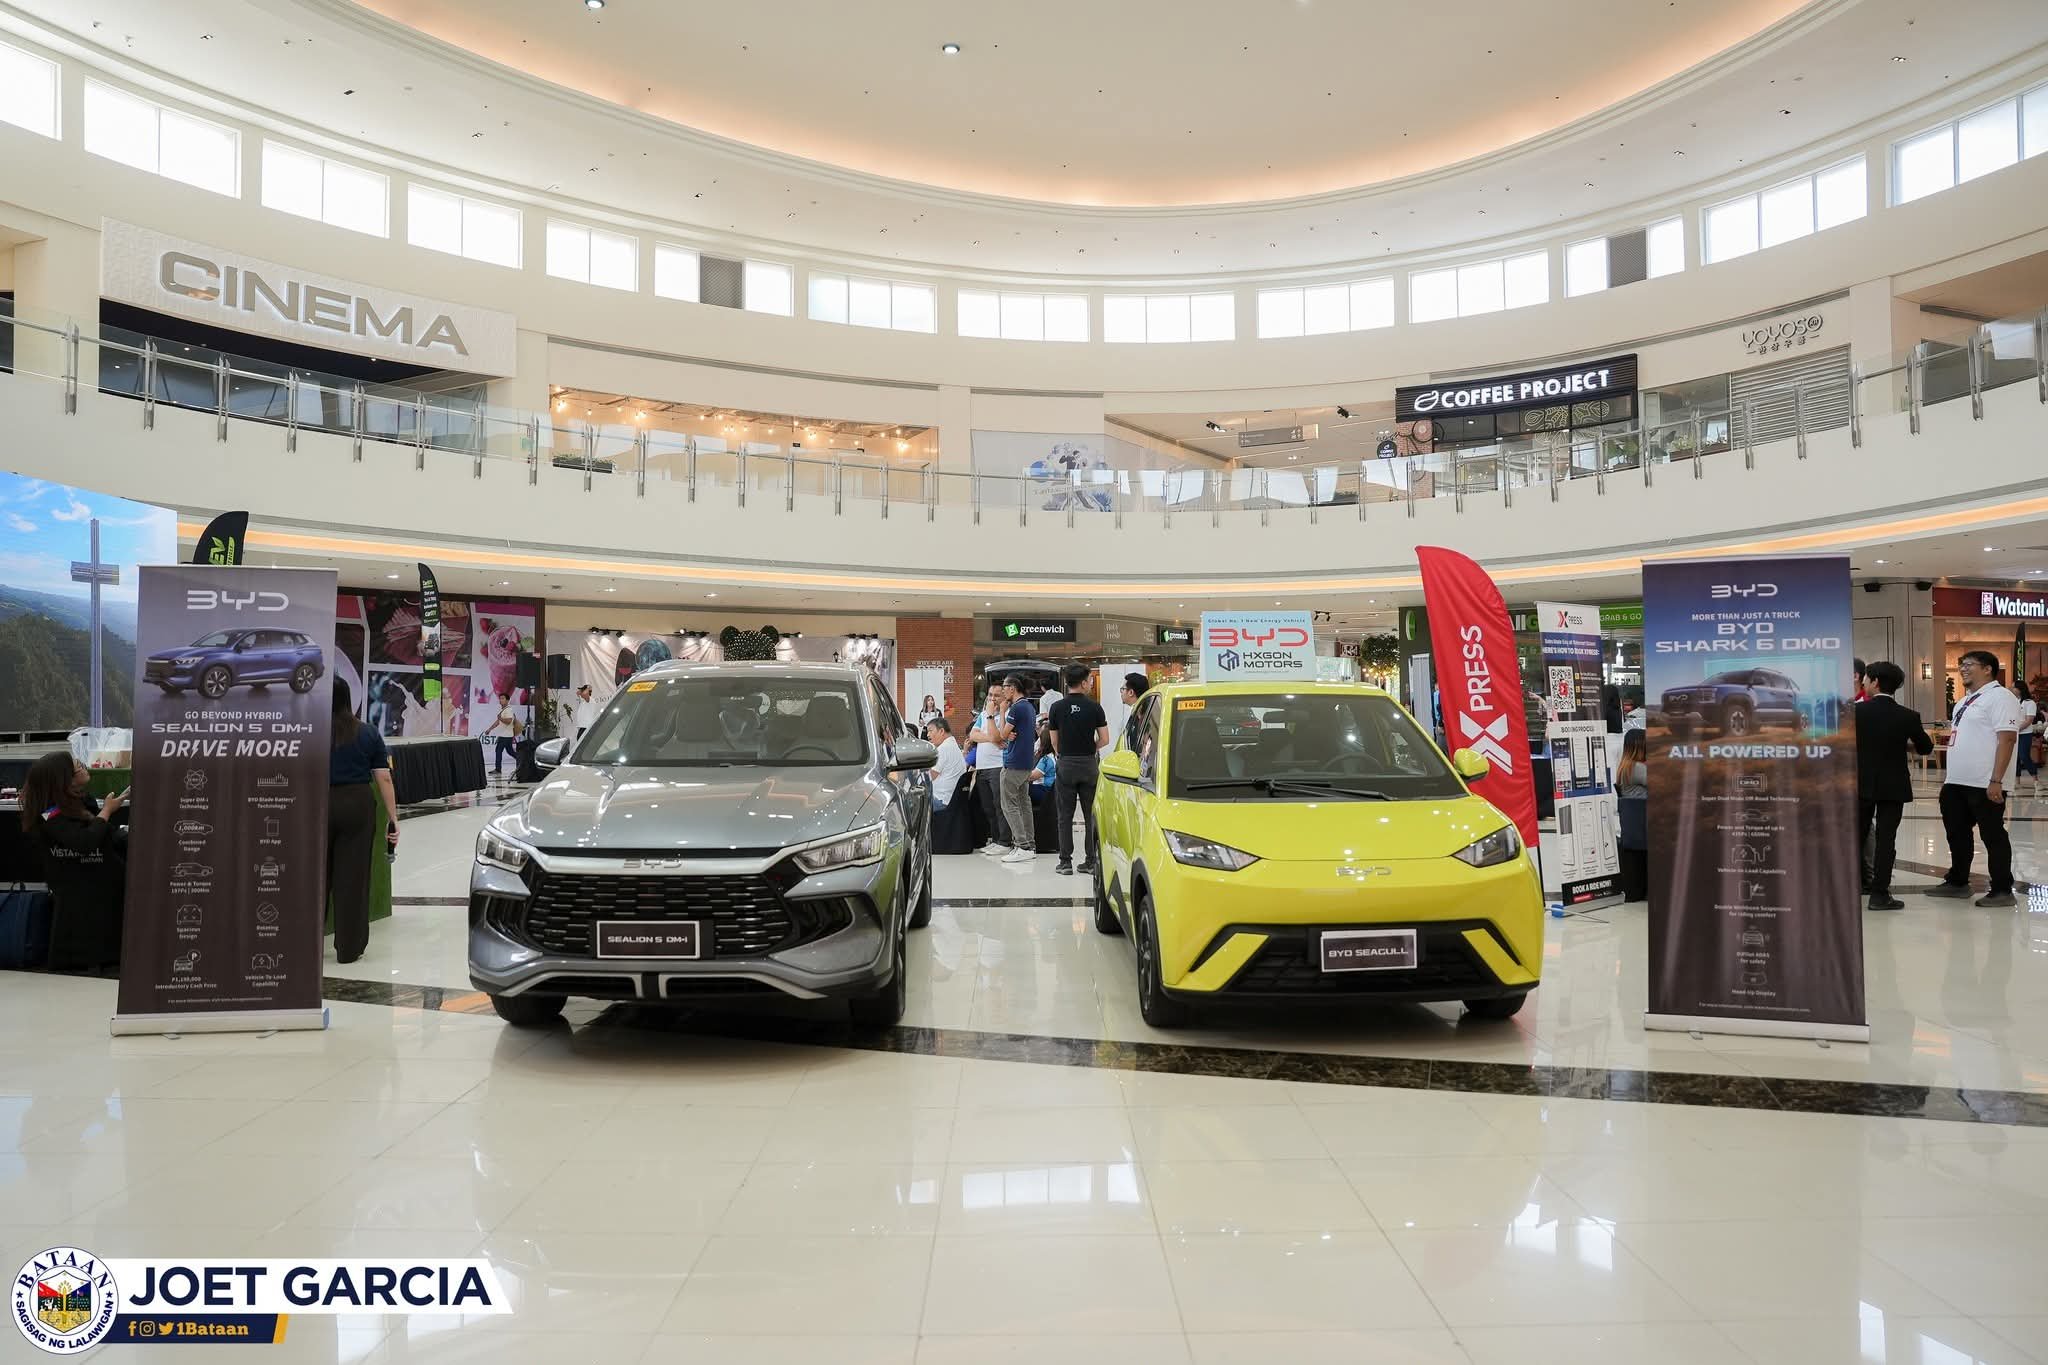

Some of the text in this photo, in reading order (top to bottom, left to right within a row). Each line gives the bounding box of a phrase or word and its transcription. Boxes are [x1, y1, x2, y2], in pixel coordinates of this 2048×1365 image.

[160, 251, 469, 357] CINEMA
[1441, 370, 1609, 409] COFFEE PROJECT
[1711, 584, 1778, 598] BYD
[187, 589, 290, 612] BYD
[1995, 596, 2045, 617] Watami
[1600, 614, 1621, 622] GRAB
[1692, 613, 1715, 621] MORE
[1717, 612, 1740, 620] THAN
[1742, 612, 1763, 620] JUST
[1771, 611, 1801, 619] TRUCK
[1020, 625, 1065, 635] greenwich
[1718, 622, 1774, 635] BYD
[1208, 628, 1309, 647] BYD
[1656, 637, 1841, 653] SHARK 6 DMO
[1243, 651, 1292, 660] HXGON
[1243, 660, 1303, 668] MOTORS
[185, 711, 283, 720] GO BEYOND HYBRID
[152, 723, 313, 733] SEALION 5 DM-i
[161, 739, 302, 758] DRIVE MORE
[1669, 745, 1832, 758] ALL POWERED UP
[50, 847, 75, 857] VISTA
[623, 858, 682, 869] BYD
[1336, 866, 1392, 877] BYD
[1572, 885, 1585, 894] BOOK
[1589, 882, 1600, 890] RIDE
[1328, 947, 1409, 958] BYD SEAGULL
